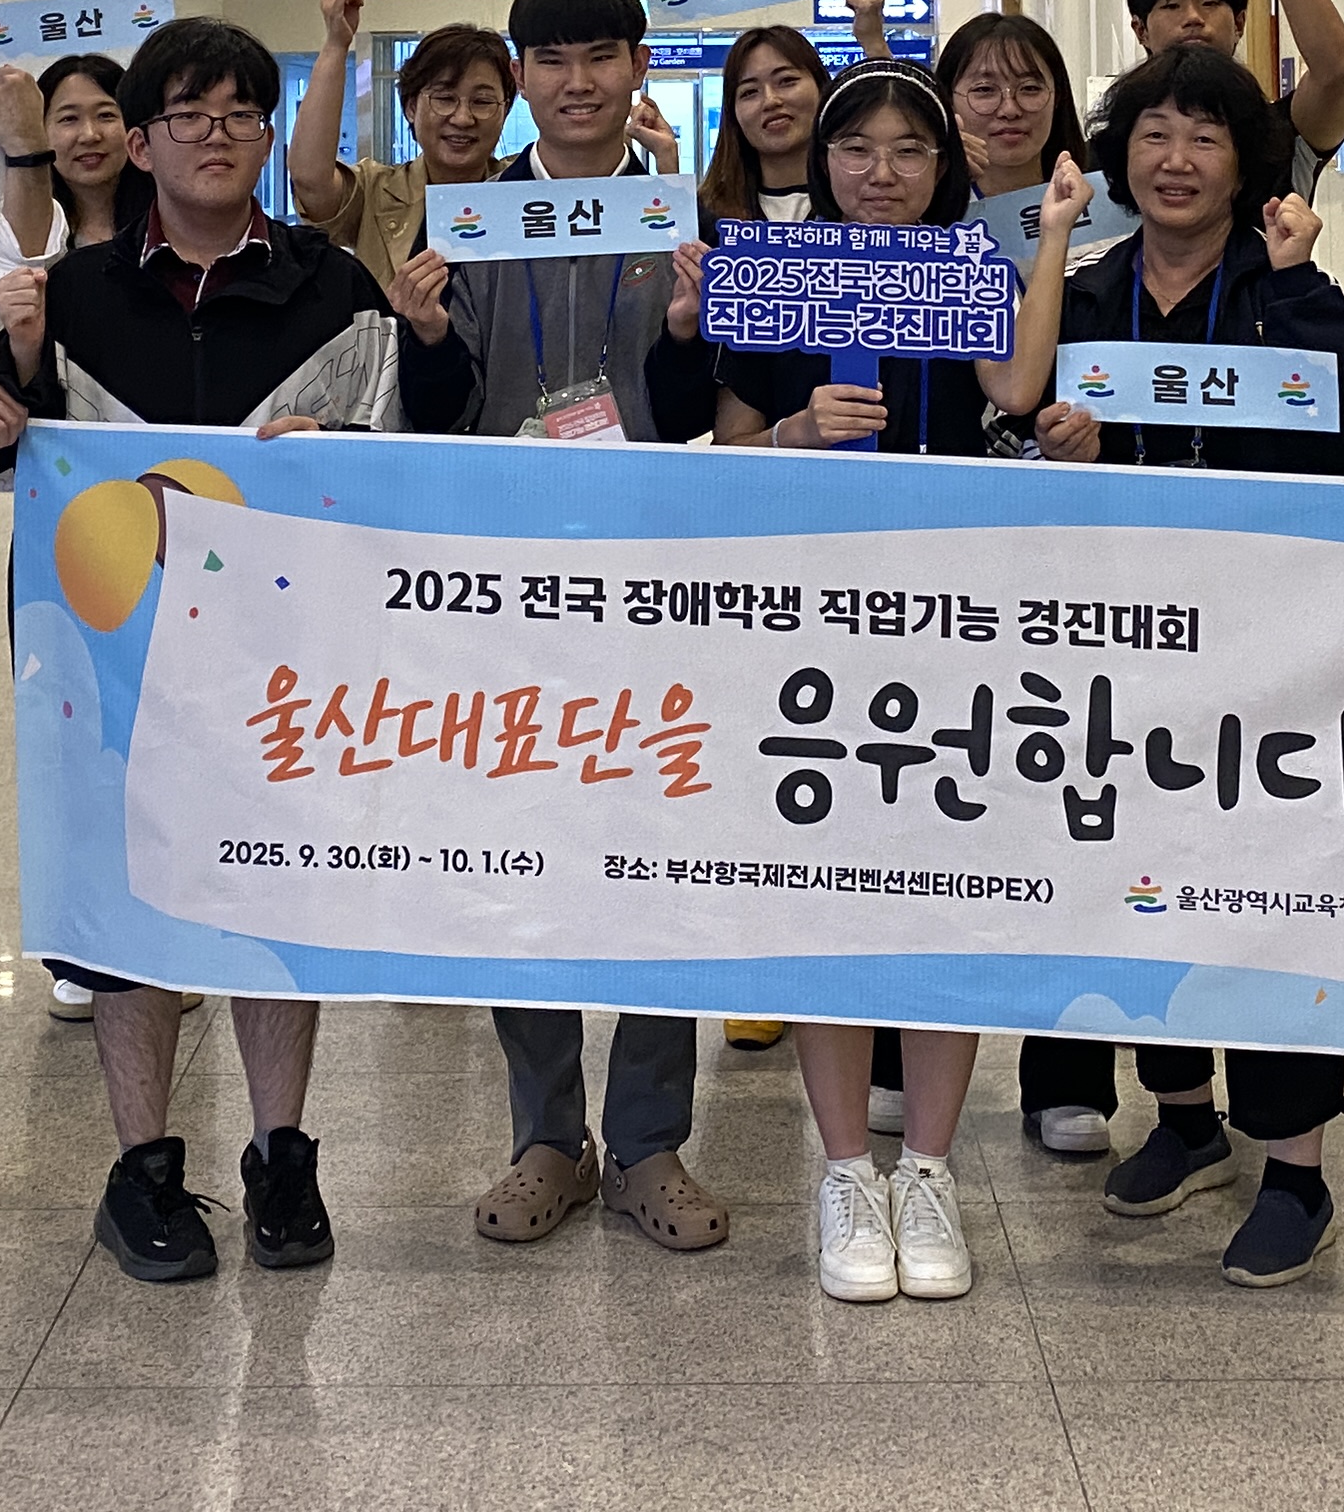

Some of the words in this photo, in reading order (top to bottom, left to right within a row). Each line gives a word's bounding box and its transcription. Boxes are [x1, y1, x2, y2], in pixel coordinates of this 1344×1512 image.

[39, 8, 103, 42] 울산
[521, 198, 604, 238] 울산
[720, 224, 760, 245] 같이
[767, 227, 842, 248] 도전하며
[849, 228, 890, 250] 함께
[897, 230, 951, 253] 키우는
[964, 232, 981, 253] 꿈
[708, 256, 806, 295] 2025
[807, 258, 874, 299] 전국
[875, 261, 1008, 305] 장애학생
[707, 298, 856, 348] 직업기능
[857, 304, 1007, 354] 경진대회
[1151, 364, 1239, 407] 울산
[385, 568, 502, 615] 2025
[519, 574, 606, 623] 전국
[622, 579, 802, 632] 장애학생
[818, 588, 1000, 643] 직업기능
[1017, 599, 1199, 653] 경진대회
[246, 664, 711, 798] 울산대표단을
[218, 839, 291, 867] 2025.
[298, 844, 319, 868] 9.
[326, 844, 411, 872] 30.(화)
[439, 848, 474, 873] 10.
[481, 849, 545, 877] 1.(수)
[604, 855, 658, 881] 장소:
[665, 858, 1054, 904] 부산항국제전시컨벤션센터(BPEX)
